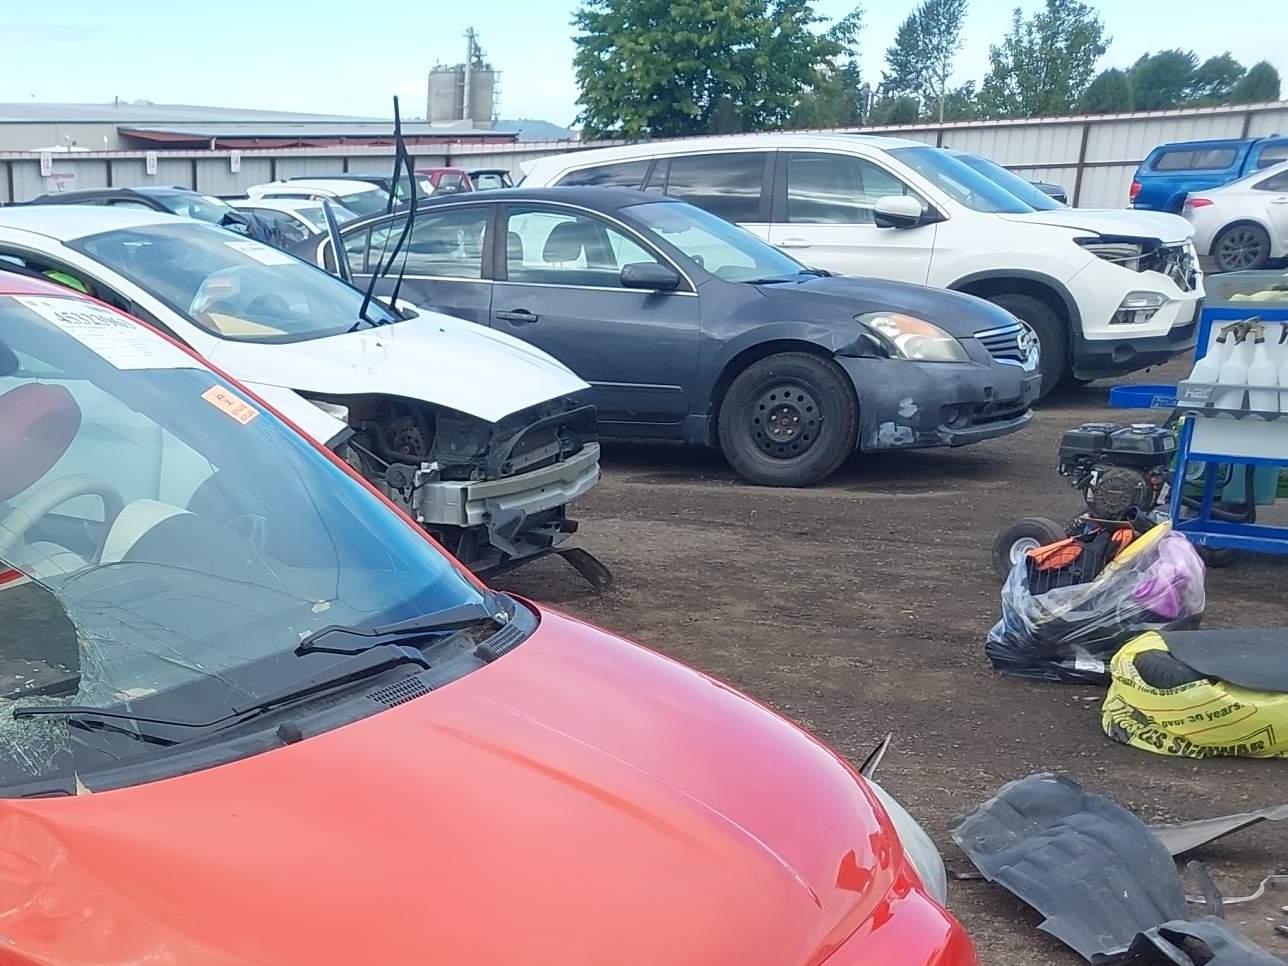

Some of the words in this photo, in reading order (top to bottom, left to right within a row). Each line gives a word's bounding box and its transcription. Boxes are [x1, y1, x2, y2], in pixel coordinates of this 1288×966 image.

[1162, 718, 1185, 729] over
[1188, 713, 1204, 723] 30
[1206, 702, 1246, 722] years.
